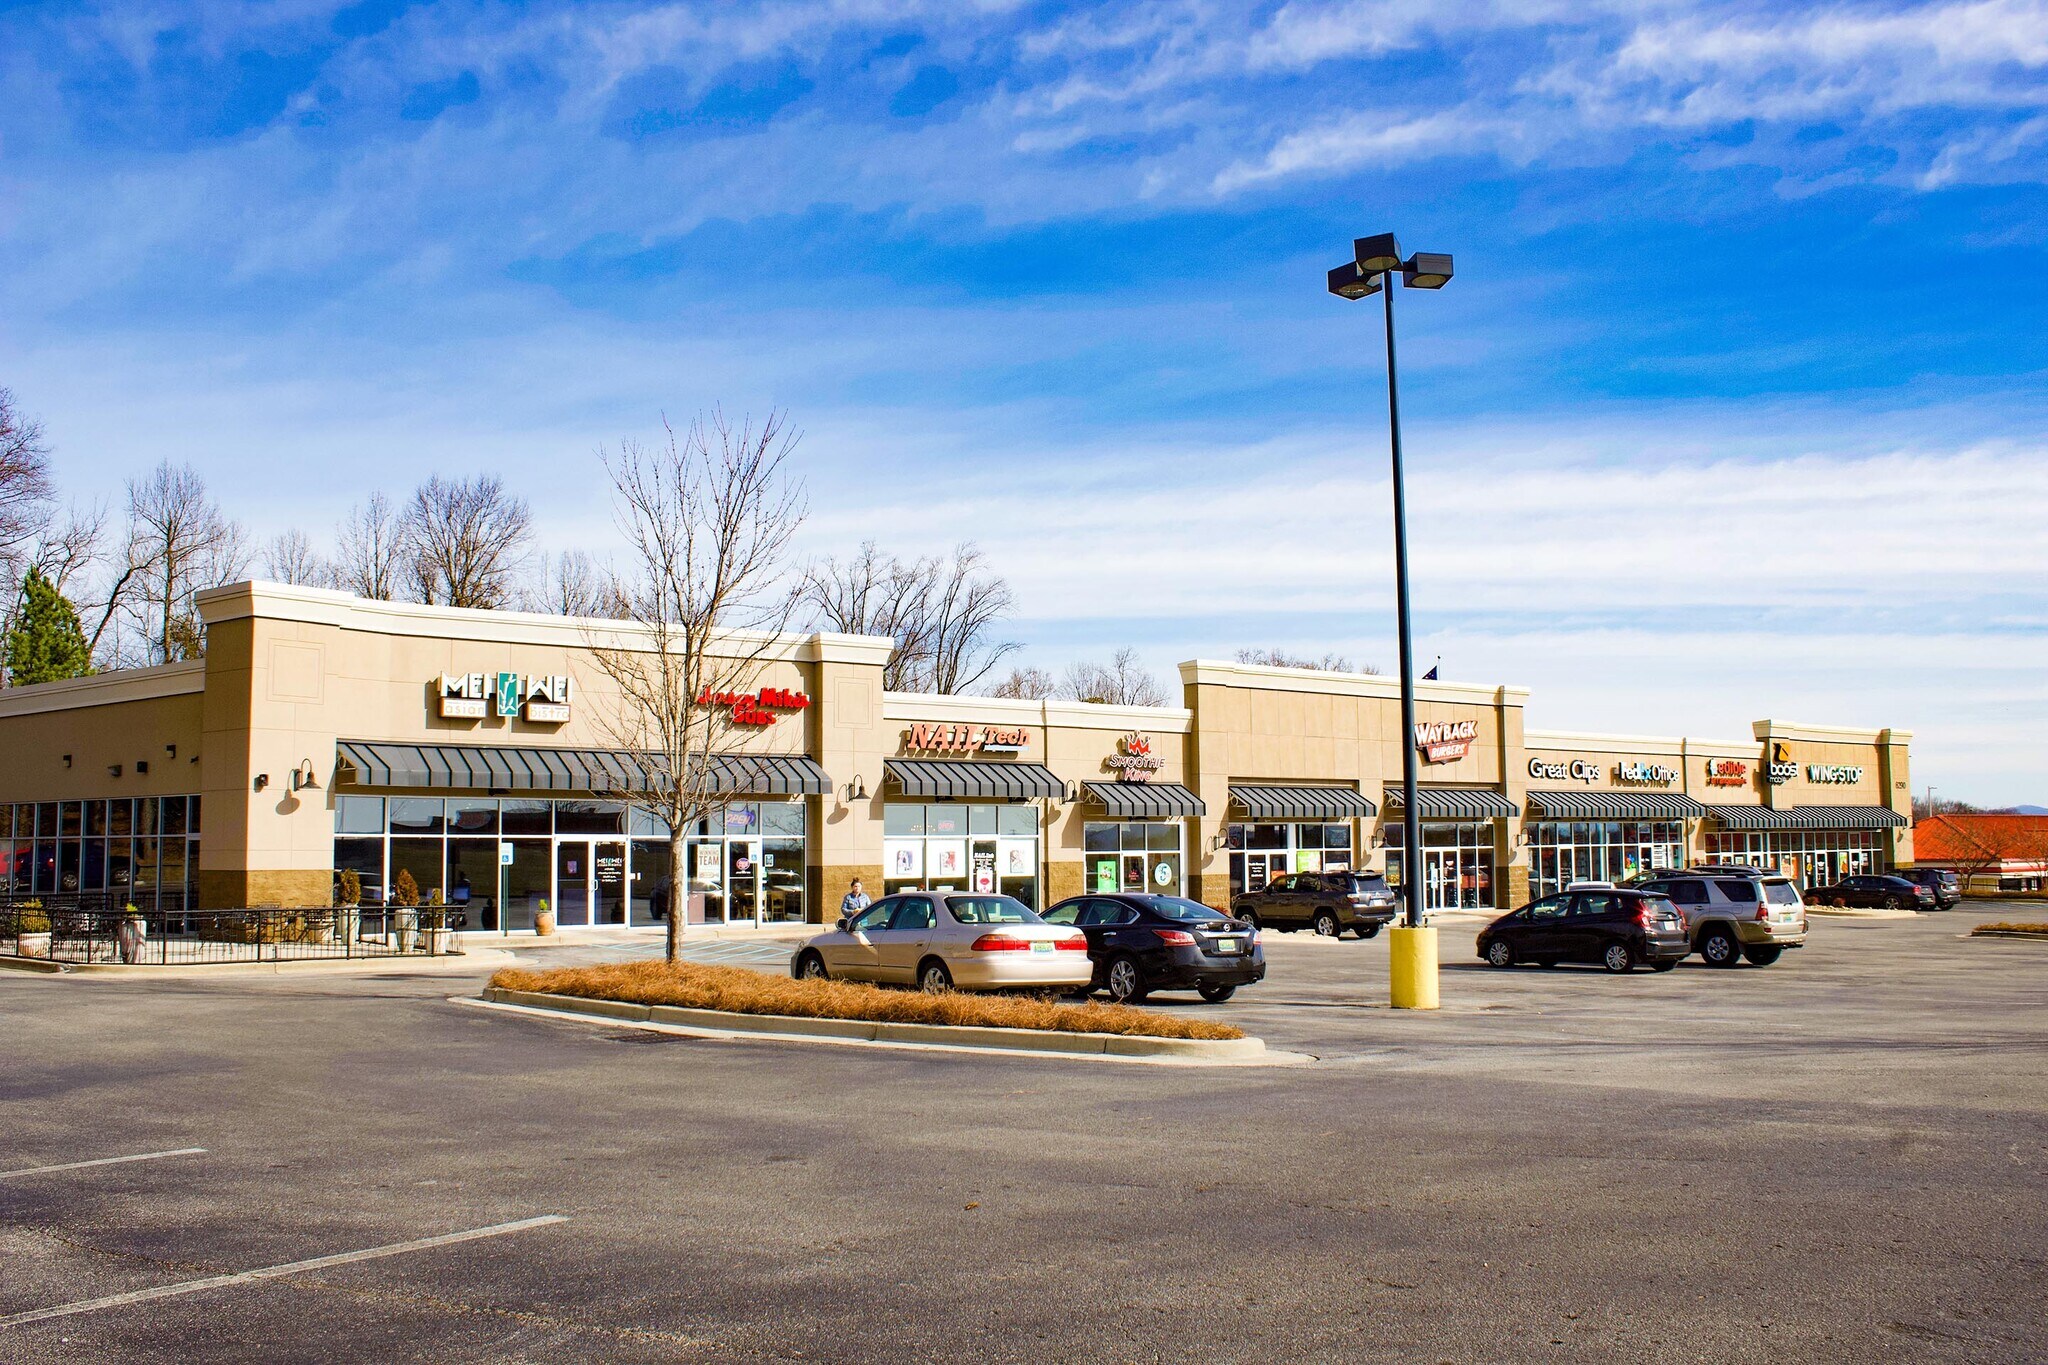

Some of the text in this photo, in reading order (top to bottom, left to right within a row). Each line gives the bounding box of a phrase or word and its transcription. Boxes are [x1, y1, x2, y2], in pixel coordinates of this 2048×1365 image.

[440, 671, 574, 703] MEI WEI
[445, 703, 485, 715] asian
[530, 706, 570, 718] bistro
[907, 723, 1031, 750] NAIL Tech
[1414, 720, 1477, 746] WAYBACK
[1431, 743, 1466, 759] BURGERS
[1110, 754, 1166, 769] SMOOTHIE
[1124, 767, 1152, 782] KING
[1529, 758, 1601, 784] Great Clips
[726, 812, 752, 825] OPEN
[699, 855, 719, 866] TEAM
